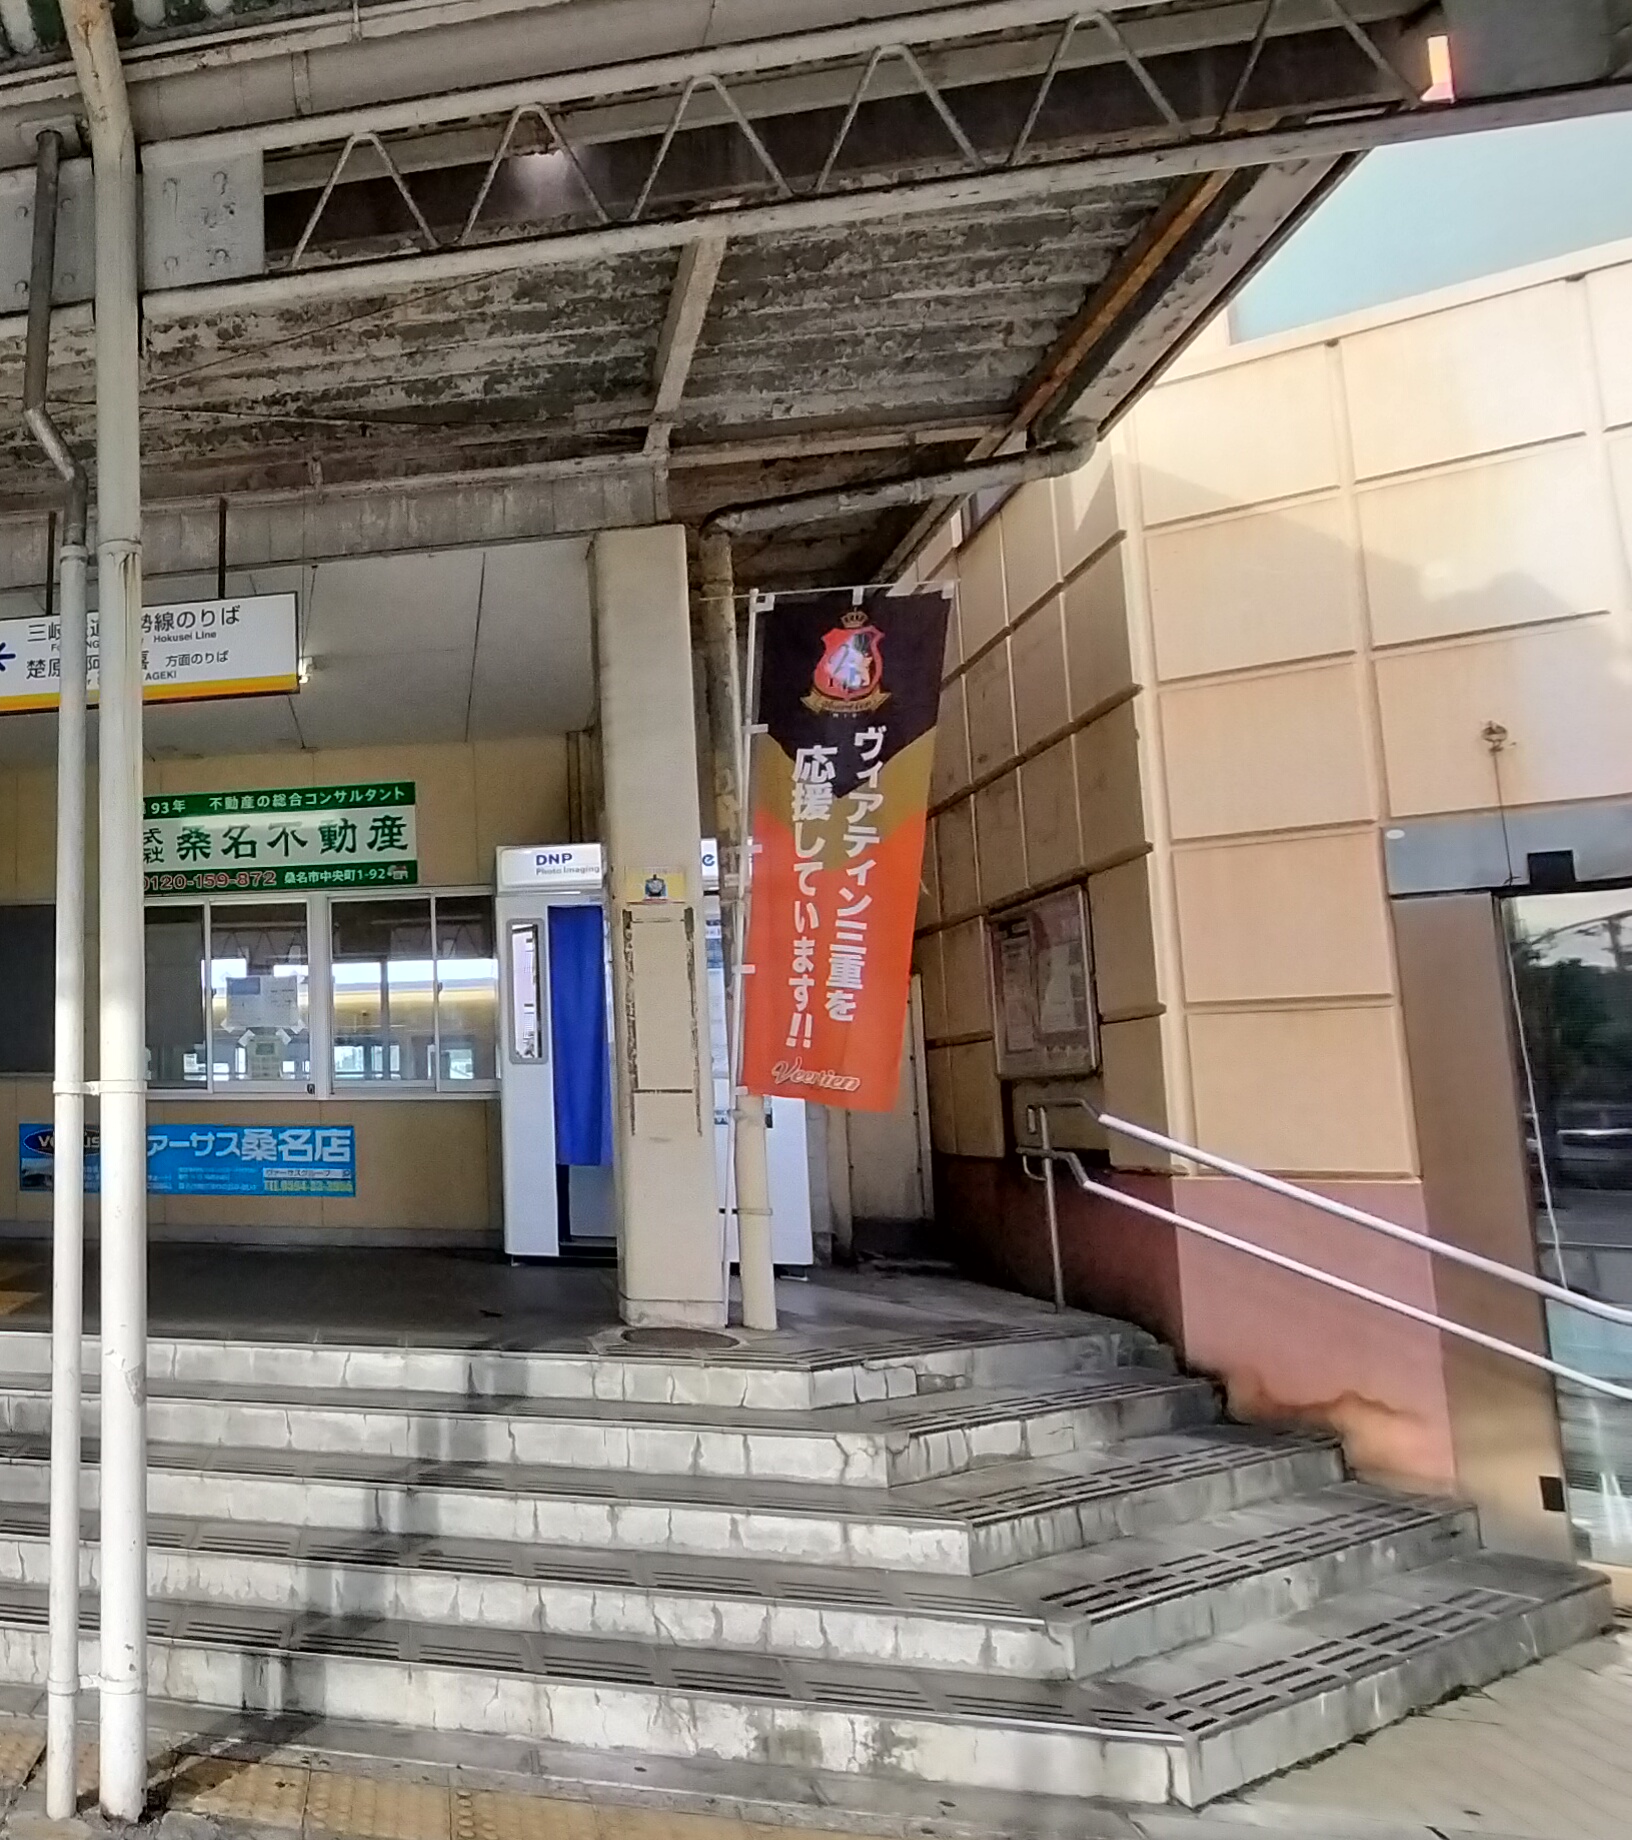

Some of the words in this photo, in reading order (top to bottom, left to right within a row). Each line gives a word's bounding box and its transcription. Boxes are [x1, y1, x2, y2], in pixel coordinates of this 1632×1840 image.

[152, 632, 194, 643] Hokusei
[195, 630, 217, 641] Line
[165, 649, 229, 668] 方面のりば
[145, 670, 178, 682] AGEKI
[209, 785, 406, 812] 不動産の総合コンサルタント
[176, 814, 409, 863] 桑名不動産
[535, 853, 573, 866] DNP
[284, 868, 386, 886] 桑名市中央町1-92
[535, 867, 562, 876] Photo
[563, 865, 601, 876] Imaging
[825, 725, 888, 1022] ヴィアティン三重を
